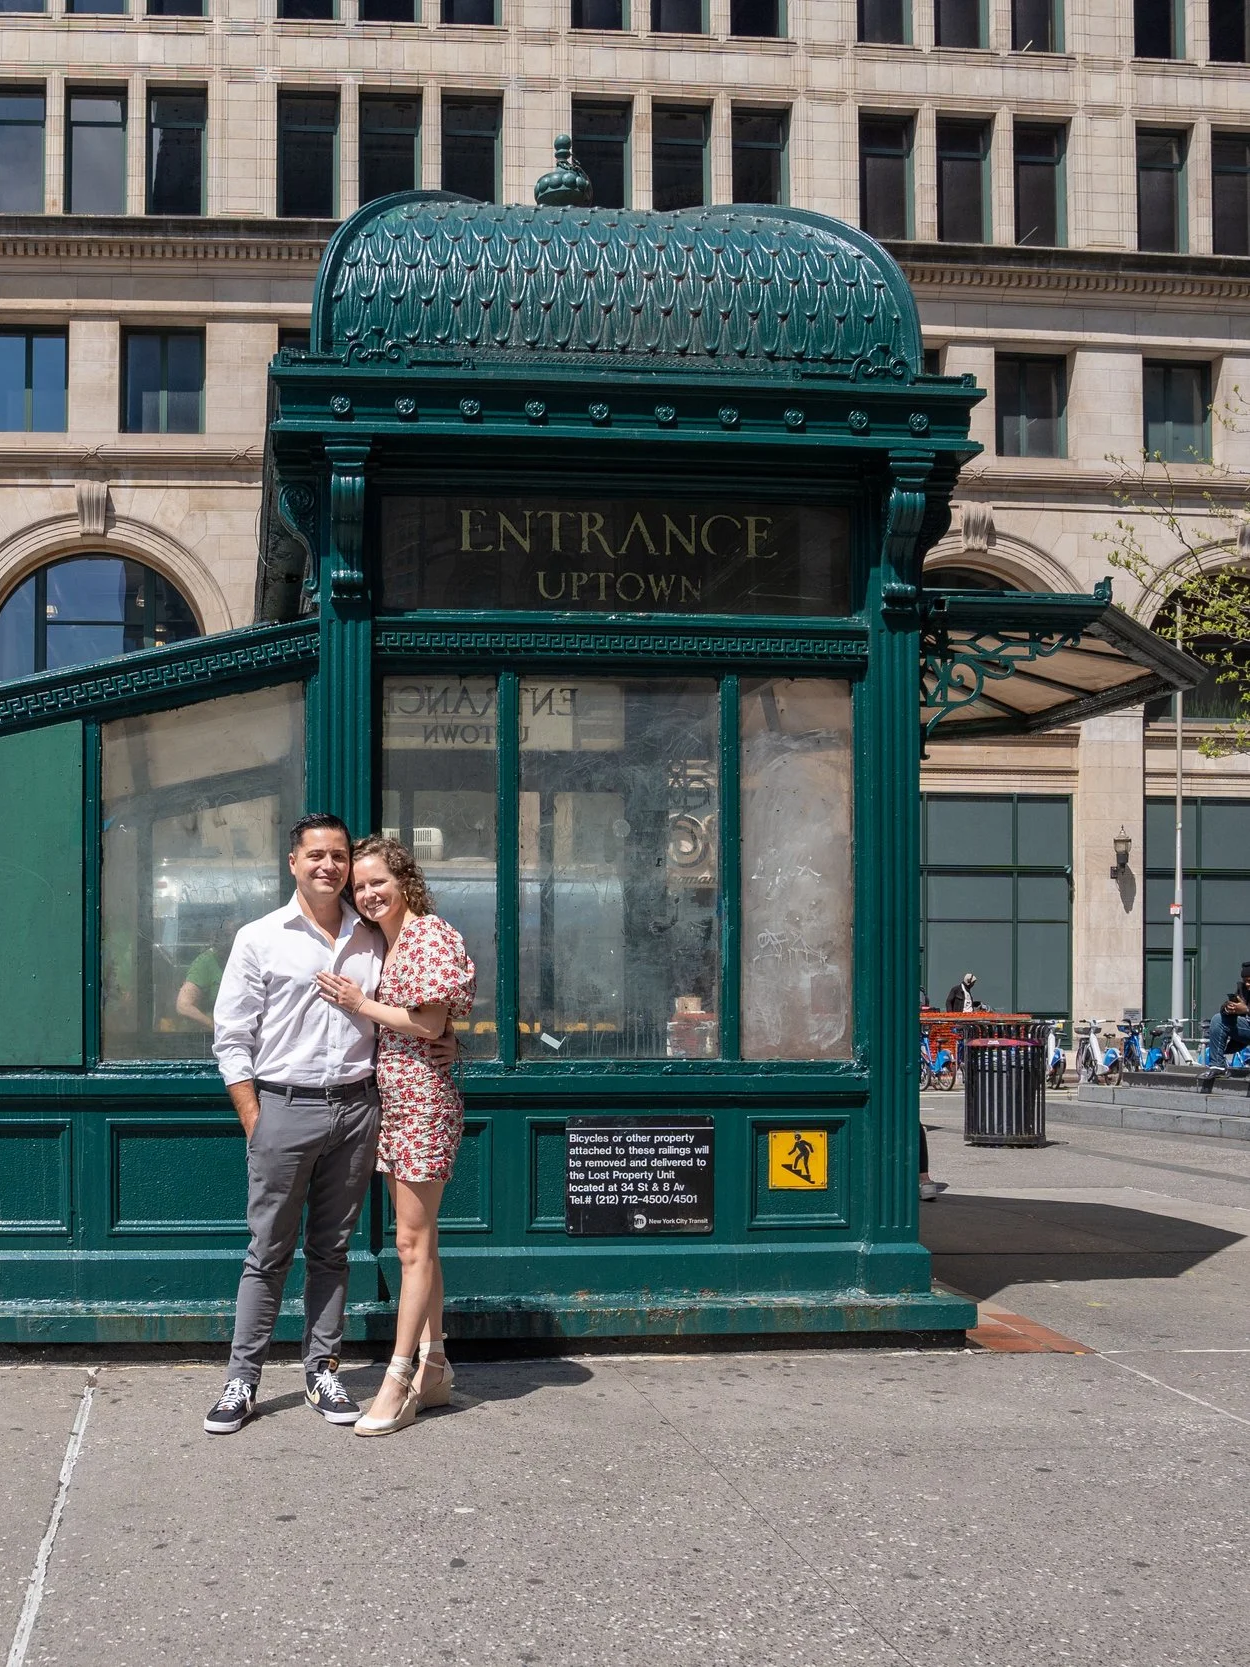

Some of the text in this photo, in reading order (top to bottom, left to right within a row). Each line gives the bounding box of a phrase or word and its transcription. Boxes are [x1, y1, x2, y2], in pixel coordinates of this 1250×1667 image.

[458, 509, 779, 559] ENTRANCE
[537, 571, 702, 602] UPTOWN
[569, 1133, 609, 1144] Bicycles
[626, 1133, 650, 1142] other
[654, 1133, 694, 1143] property
[569, 1145, 709, 1156] attached to these railings will
[569, 1158, 706, 1167] be removed and delivered to
[569, 1170, 675, 1180] the Lost Property Unit
[569, 1182, 685, 1192] located at 34 St & 8 Av
[569, 1194, 698, 1205] Tel.# (212) 712-4500/4501
